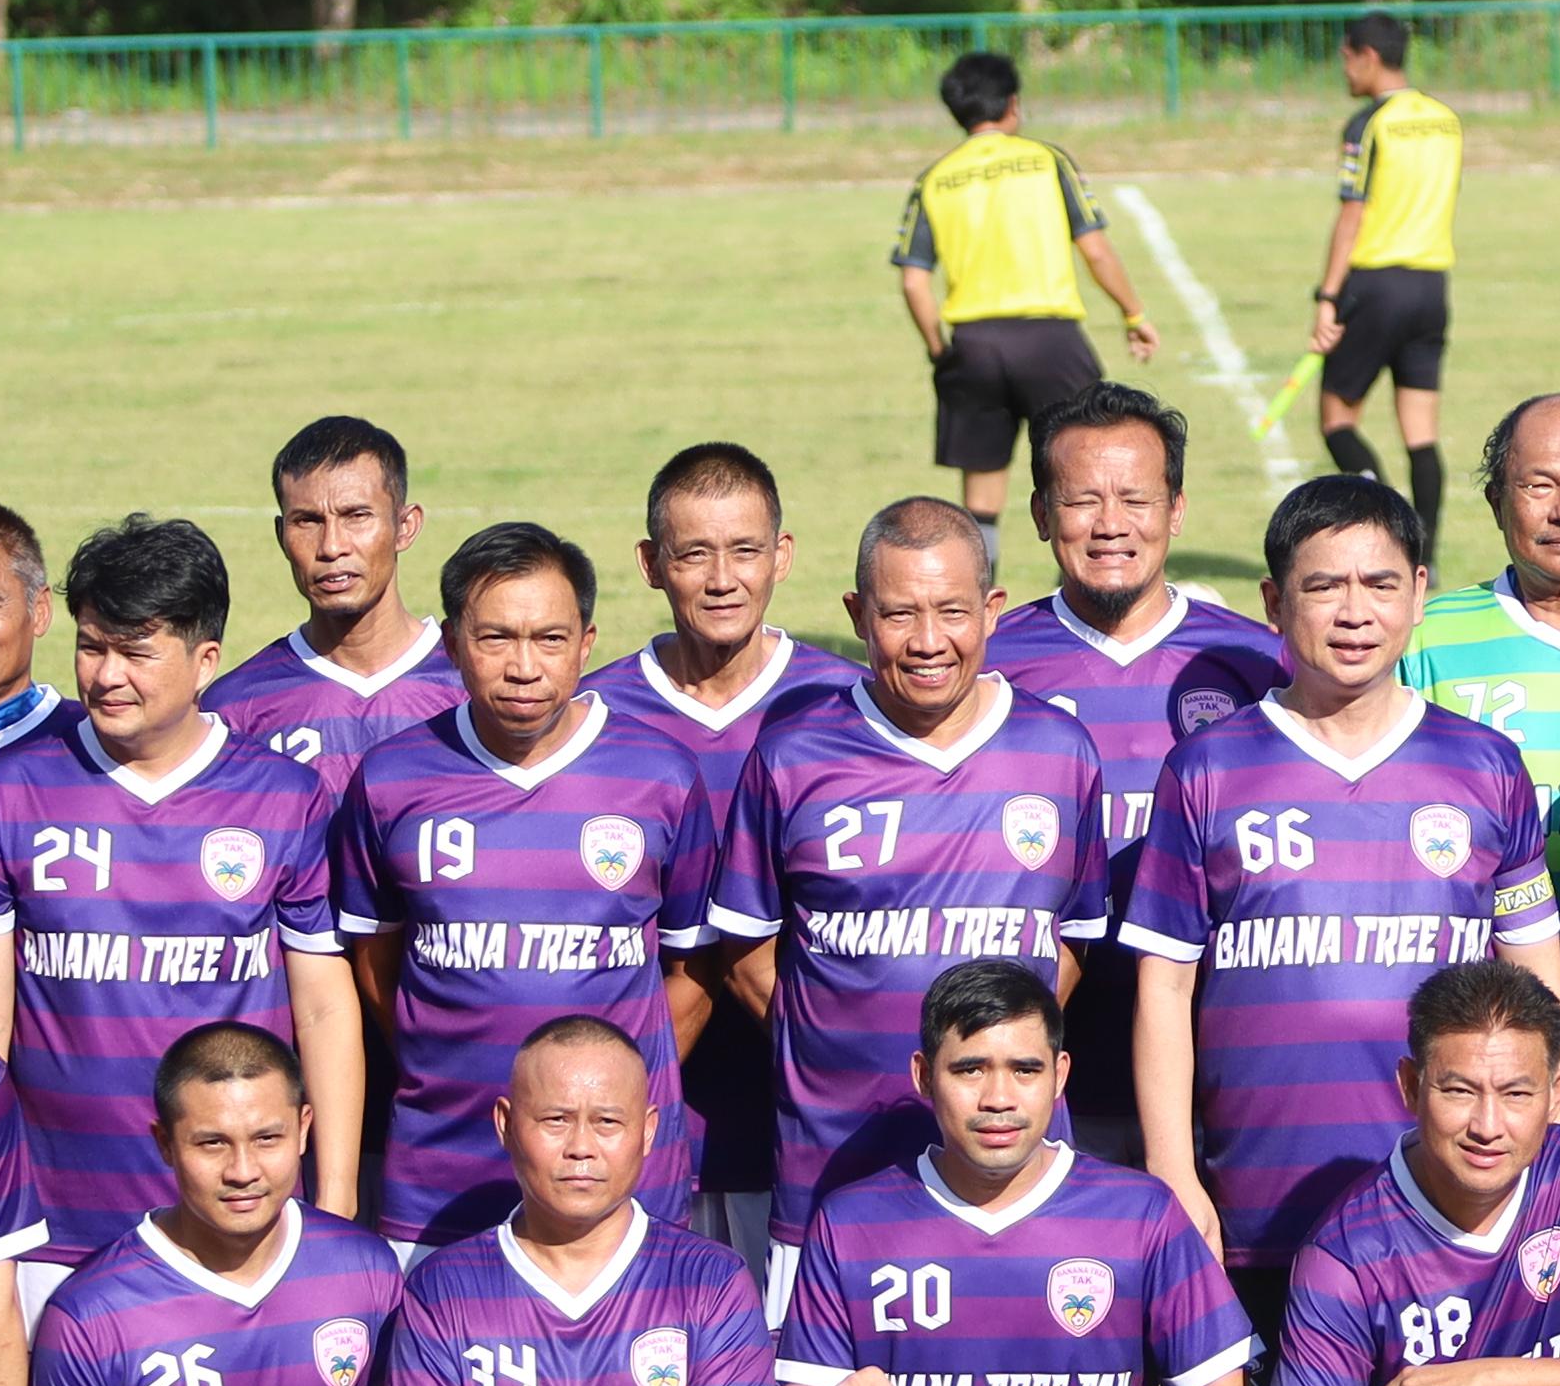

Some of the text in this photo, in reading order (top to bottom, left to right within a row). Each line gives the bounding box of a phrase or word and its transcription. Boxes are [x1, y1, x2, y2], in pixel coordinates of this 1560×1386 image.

[935, 156, 1047, 193] REFEREE
[1199, 702, 1221, 712] TAK
[1454, 680, 1529, 745] 72
[32, 825, 112, 893] 24
[224, 843, 244, 853] TAK
[417, 815, 476, 883] 19
[604, 830, 625, 841] TAK
[823, 799, 904, 872] 27
[1235, 807, 1315, 876] 66
[24, 927, 129, 982] BANANA
[140, 934, 225, 986] TREE
[414, 922, 506, 976] BANANA
[518, 924, 604, 974] TREE
[808, 907, 931, 959] BANANA
[940, 907, 1027, 960] TREE
[1215, 916, 1341, 971] BANANA
[1352, 915, 1439, 971] TREE
[870, 1262, 952, 1333] 20
[1072, 1275, 1093, 1285] TAK
[334, 1335, 353, 1346] TAK
[653, 1344, 673, 1355] TAK
[1399, 1295, 1473, 1367] 88
